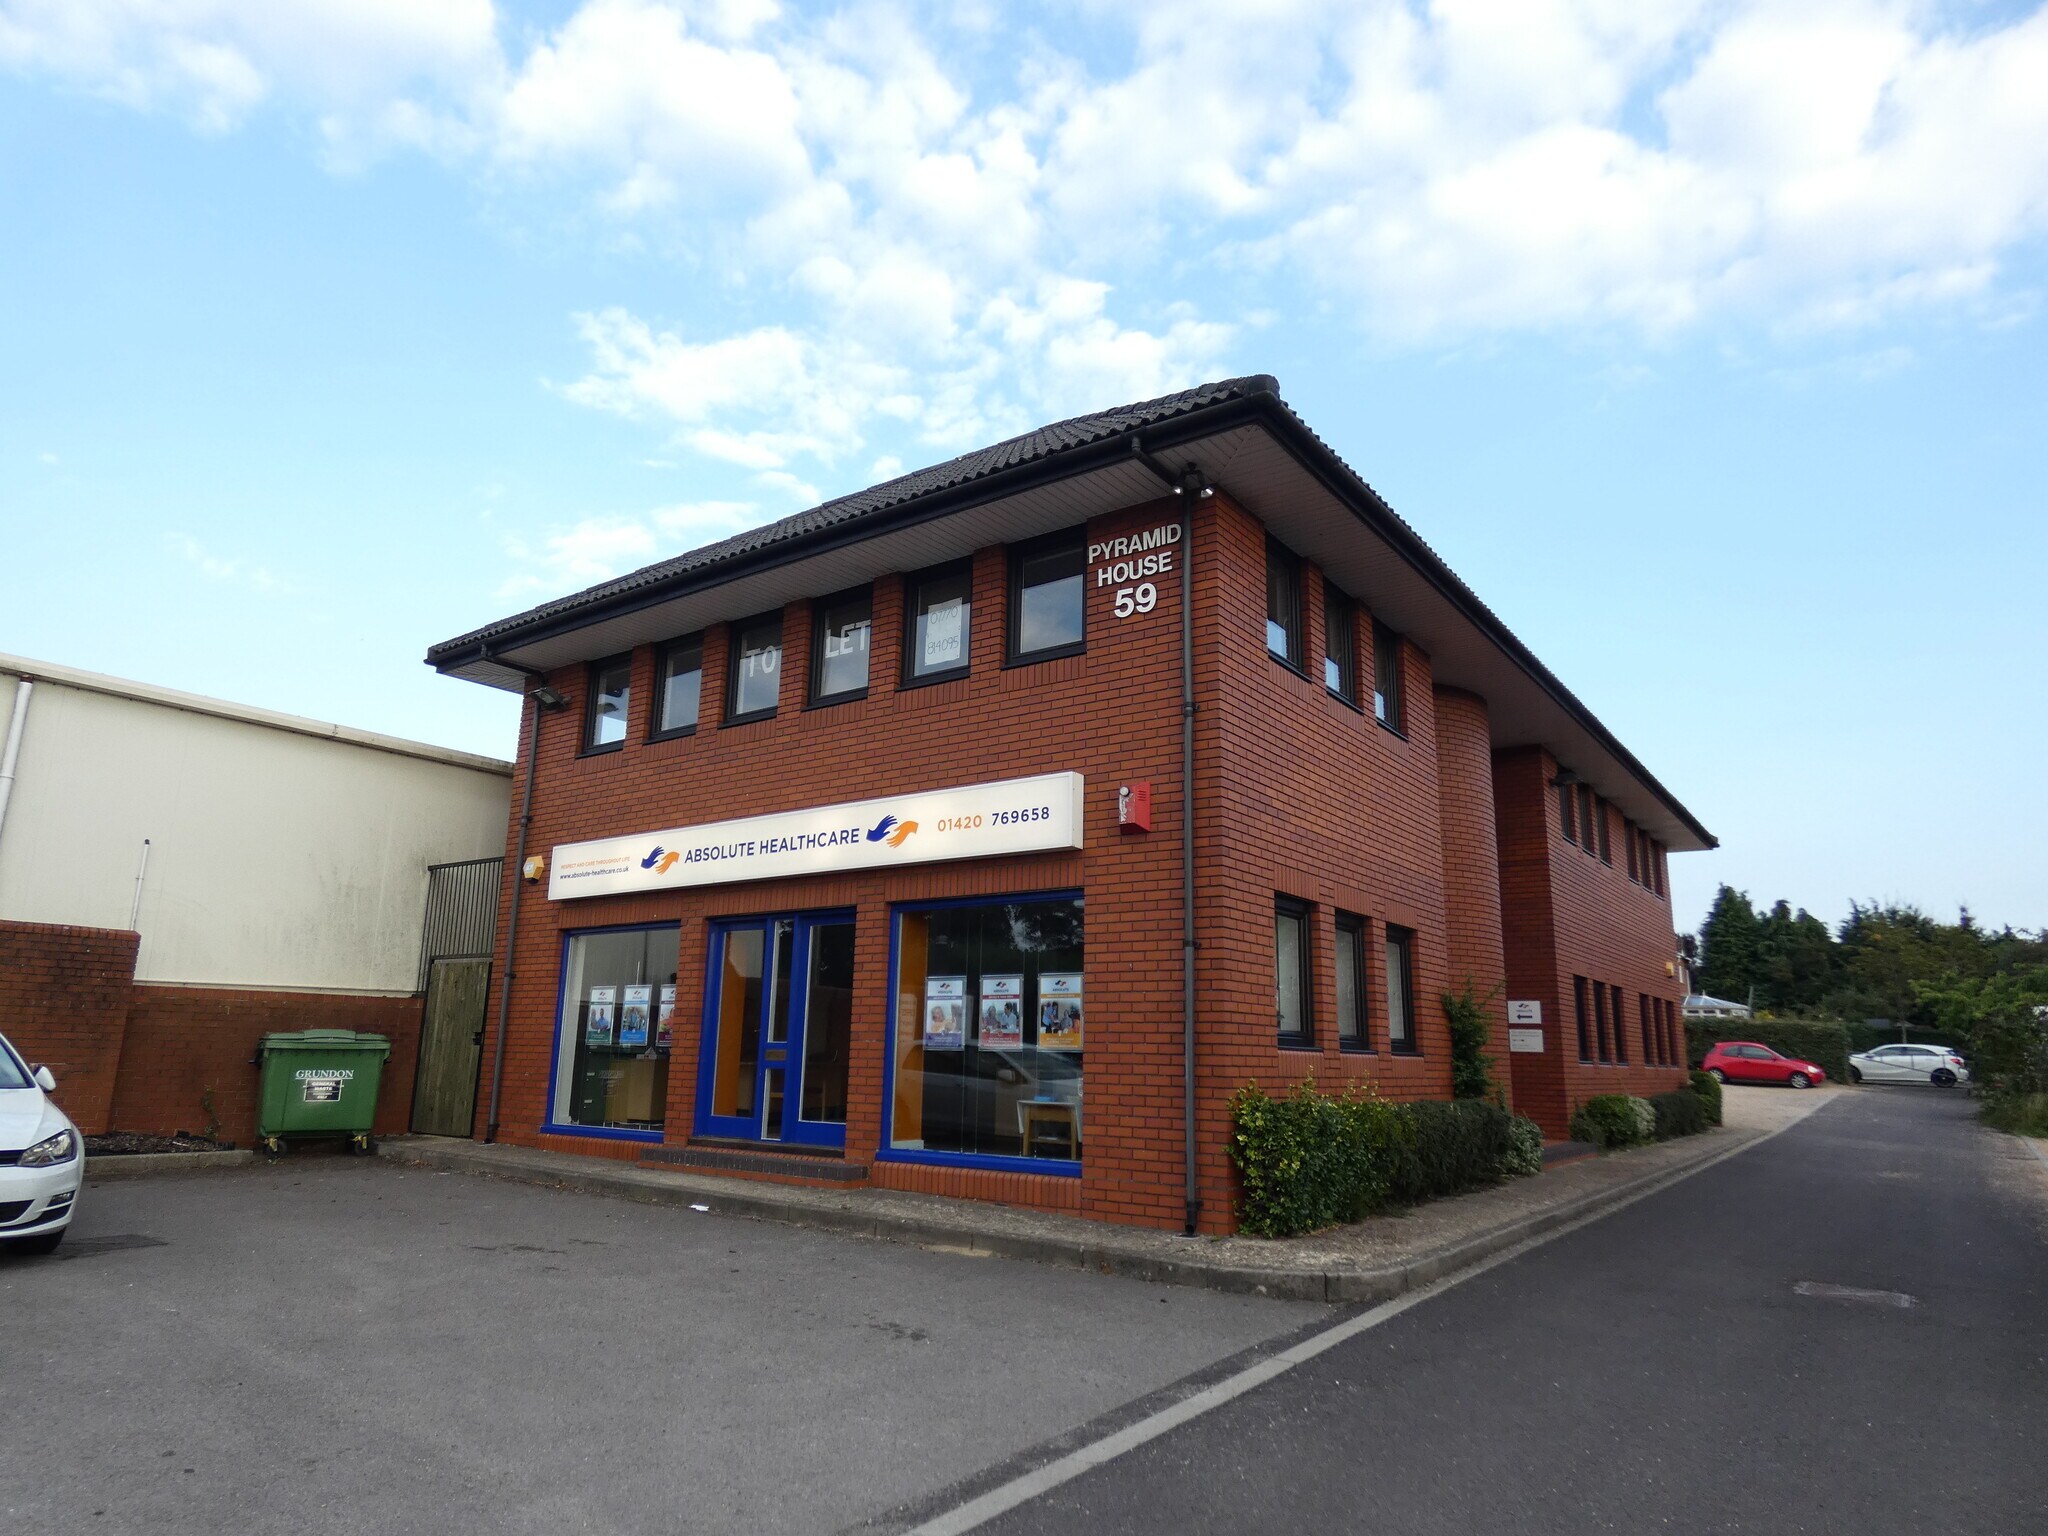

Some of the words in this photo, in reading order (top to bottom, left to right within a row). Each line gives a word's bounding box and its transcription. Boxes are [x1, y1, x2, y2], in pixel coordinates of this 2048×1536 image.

[1088, 523, 1182, 564] PYRAMID
[1098, 551, 1173, 587] HOUSE
[1113, 582, 1157, 618] 59
[746, 645, 777, 678] TO
[825, 619, 871, 659] LET
[927, 635, 959, 655] 814095
[937, 815, 983, 832] 01420
[992, 806, 1050, 826] 769658
[684, 841, 755, 863] ABSOLUTE
[759, 828, 860, 854] HEALTHCARE
[560, 866, 629, 879] www.absolute-healthcare.co.uk
[295, 1069, 355, 1078] GRUNDON
